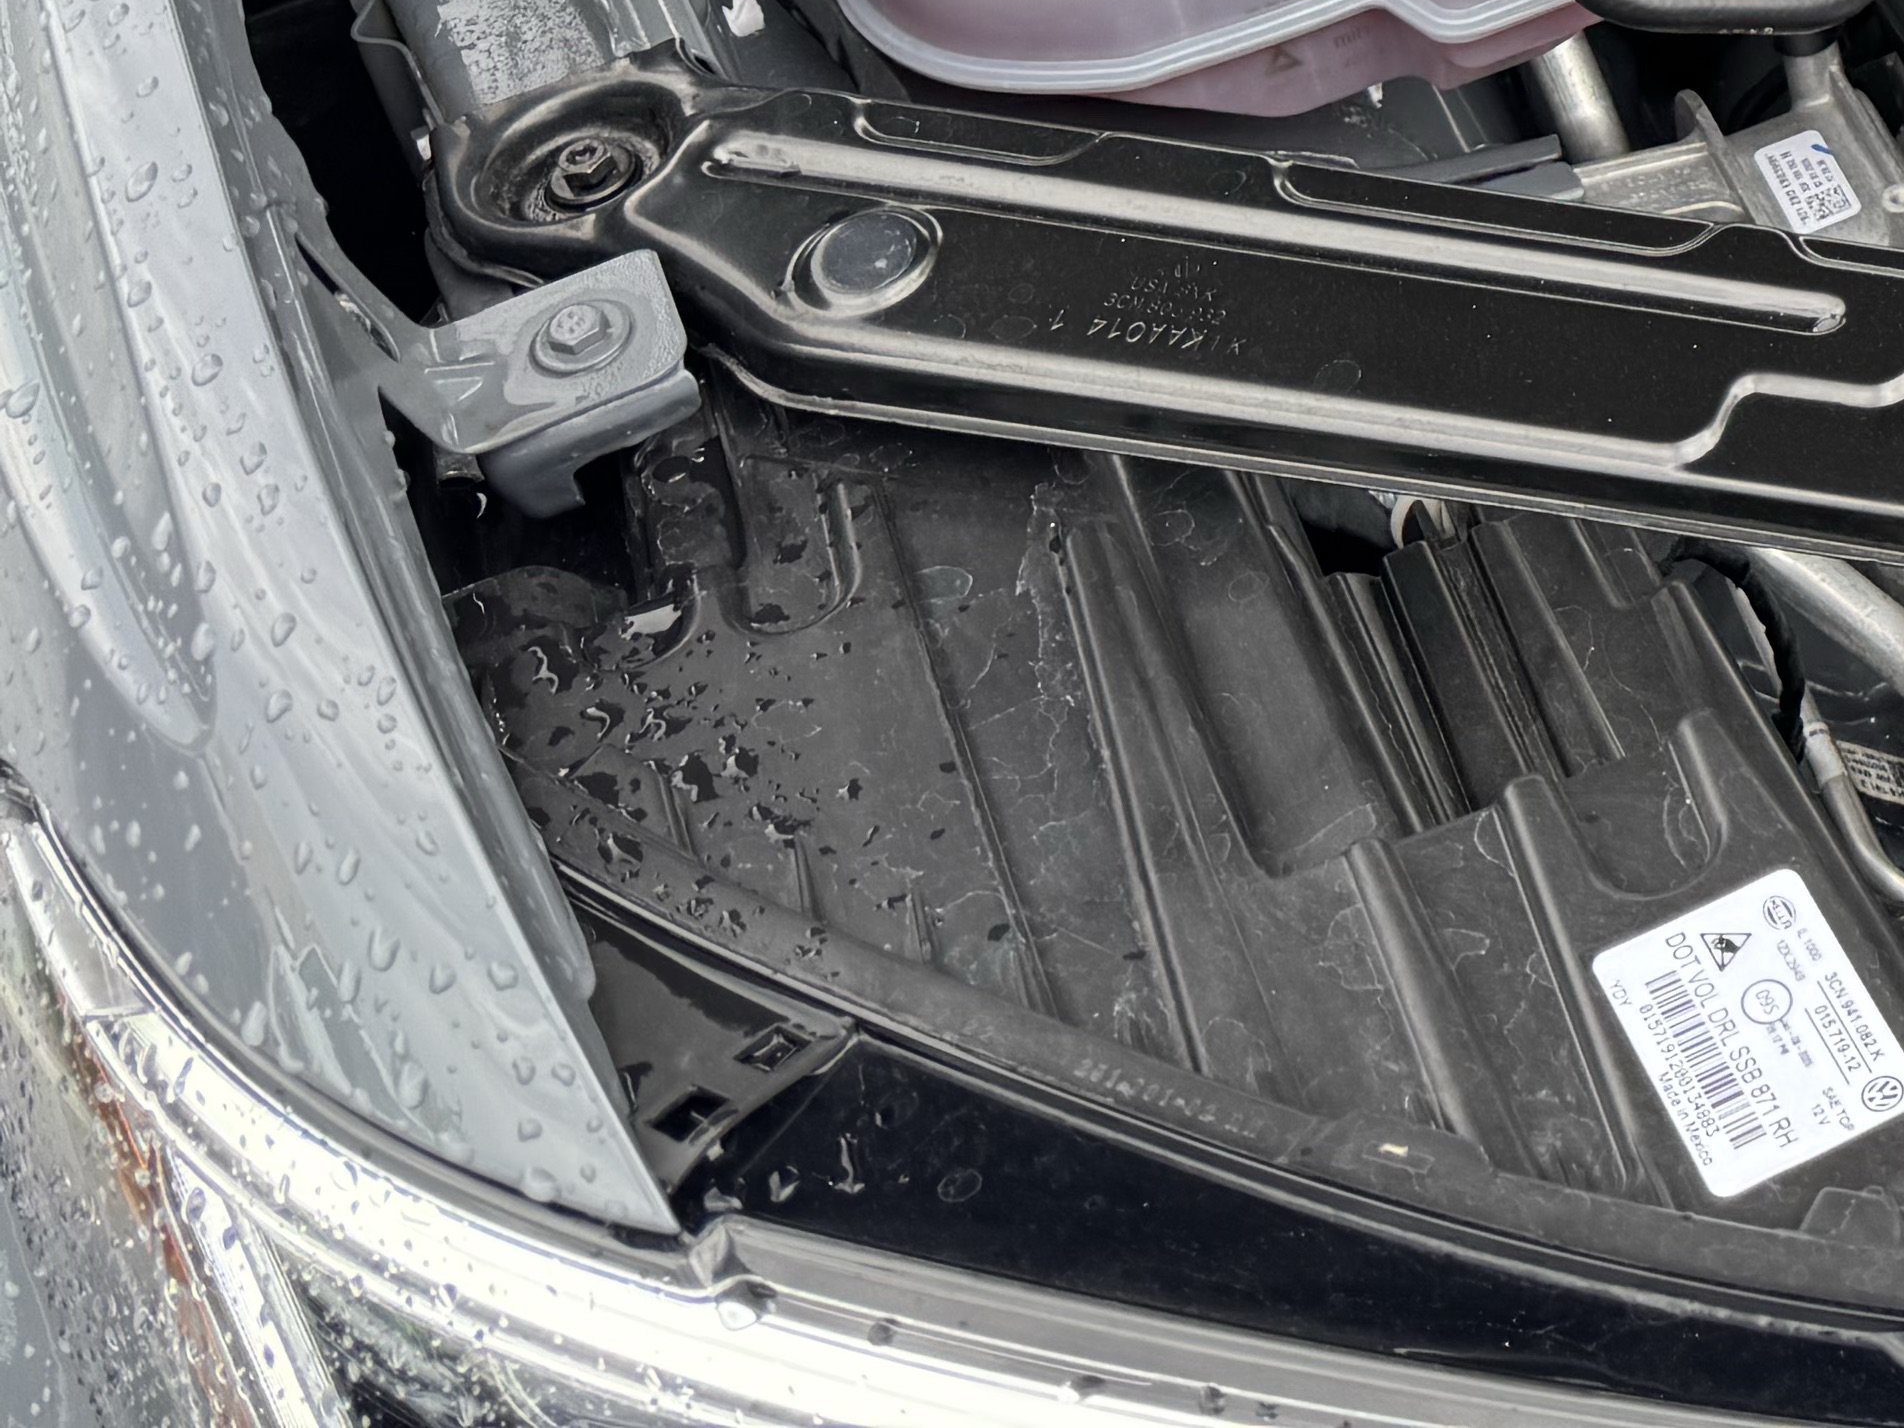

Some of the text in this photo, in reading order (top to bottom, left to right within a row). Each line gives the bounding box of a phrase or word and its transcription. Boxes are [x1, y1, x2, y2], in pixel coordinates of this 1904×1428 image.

[1663, 930, 1701, 973] DOT
[1685, 968, 1722, 1009] VOL
[1705, 1005, 1743, 1047] DRL
[1727, 1043, 1764, 1084] SSB
[1748, 1081, 1782, 1117] 871
[1767, 1115, 1800, 1149] RH
[1656, 1070, 1716, 1167] Made in Mexico
[1809, 1103, 1825, 1117] 12
[1820, 1085, 1842, 1110] SAE
